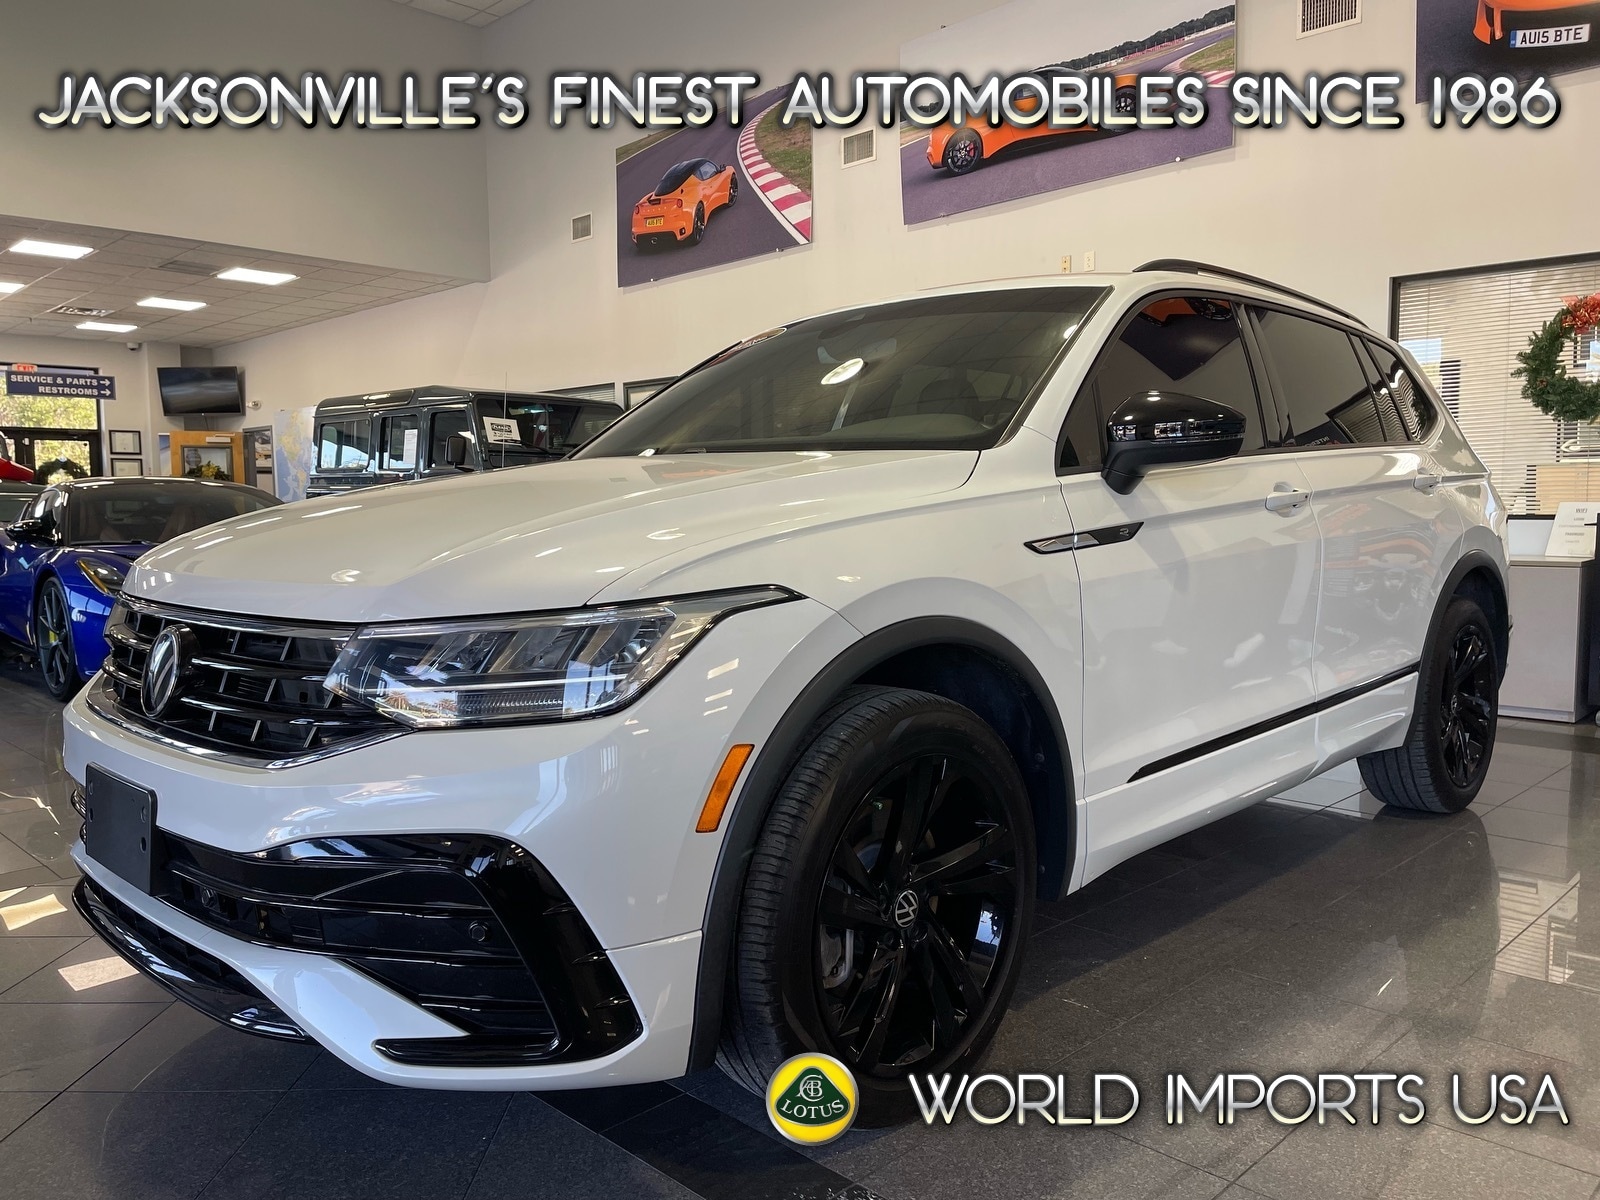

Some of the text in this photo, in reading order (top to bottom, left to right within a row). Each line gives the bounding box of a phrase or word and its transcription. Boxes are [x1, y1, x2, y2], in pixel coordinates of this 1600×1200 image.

[1520, 27, 1583, 45] AU15 BTE
[10, 374, 98, 387] SERVICE & PARTS
[38, 386, 99, 396] RESTROOMS
